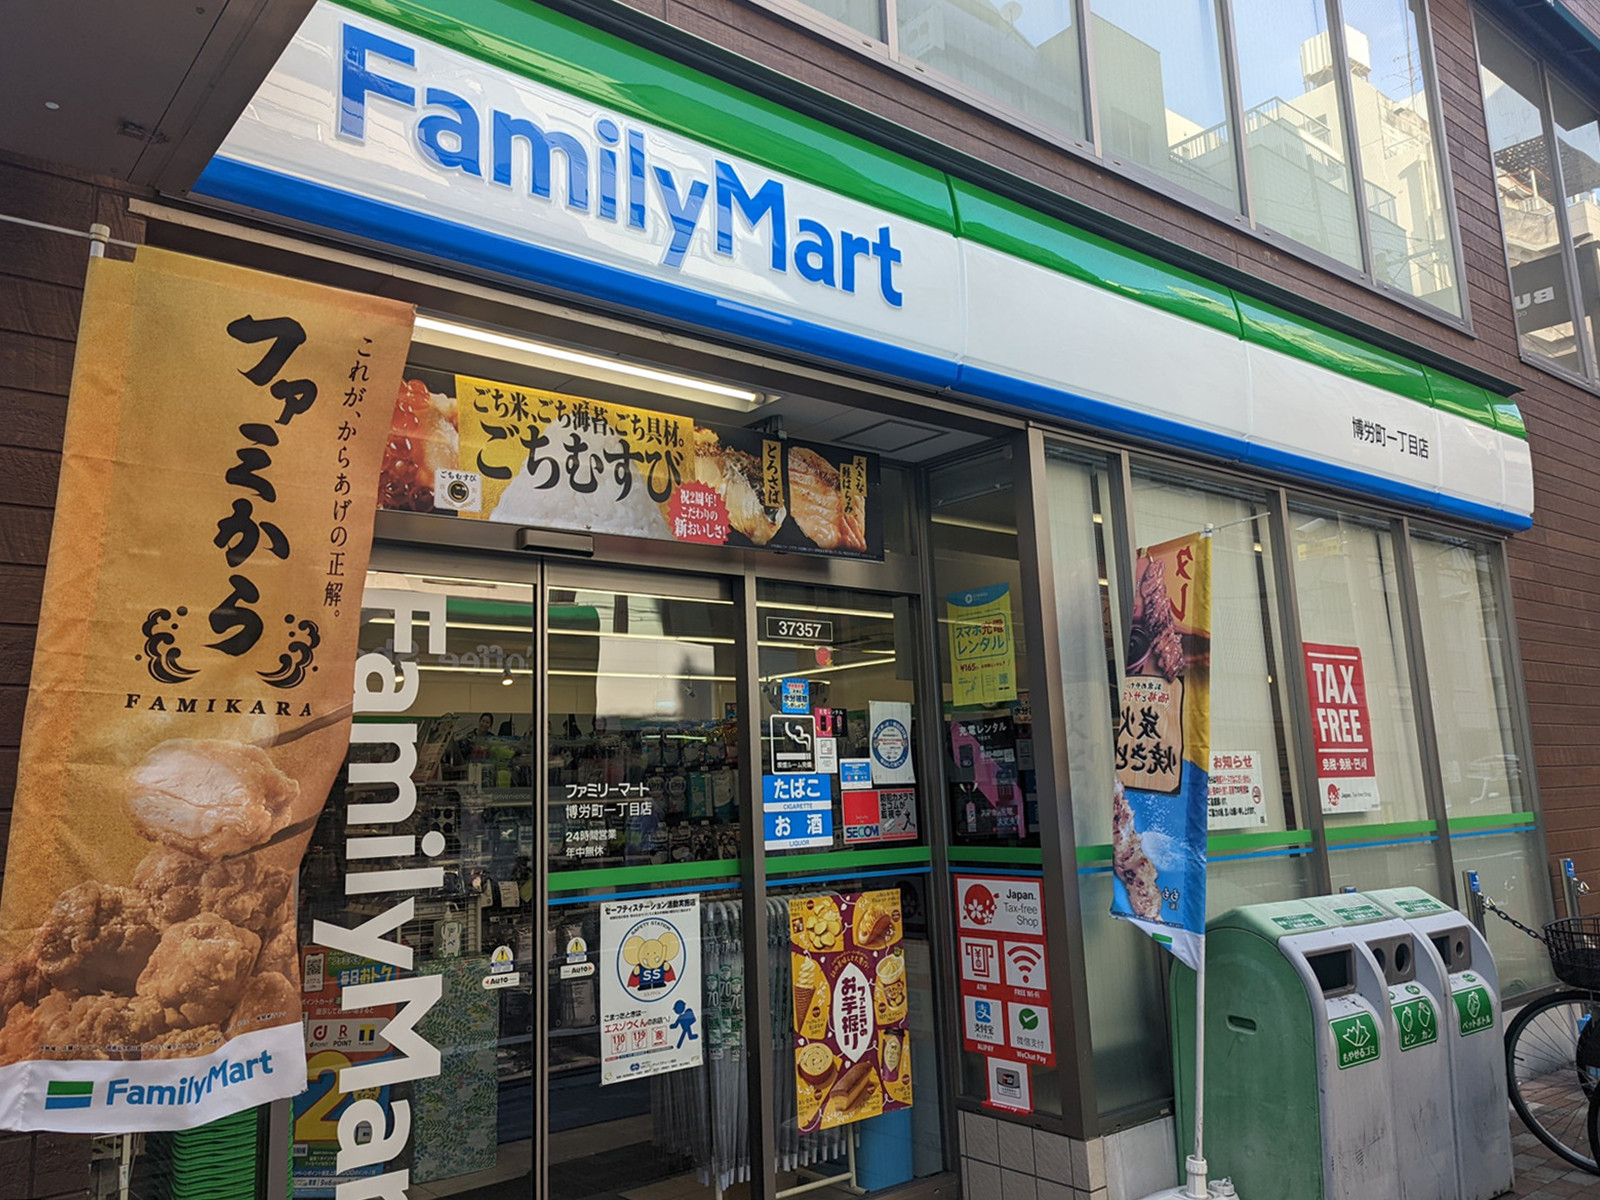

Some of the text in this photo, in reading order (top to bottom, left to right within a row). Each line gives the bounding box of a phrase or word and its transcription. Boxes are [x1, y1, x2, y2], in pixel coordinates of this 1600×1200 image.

[338, 21, 903, 308] FamilyMart
[473, 386, 686, 448] ごち米、ごち海苔、ごち具材。
[1352, 416, 1429, 459] 博労町一丁目店
[476, 421, 682, 504] ごちむすび
[323, 337, 372, 618] これが、からあげの正解。
[766, 444, 780, 506] とろさば
[855, 458, 866, 494] 大きな
[203, 315, 318, 656] ファミから
[842, 466, 853, 513] 鮭はらみ
[680, 506, 718, 521] こだわりの
[778, 621, 822, 637] 37357
[957, 635, 1005, 655] レンタル
[1312, 662, 1358, 704] TAX
[124, 693, 312, 717] FAMIKARA
[958, 721, 1007, 737] 充電レンタル
[1316, 707, 1364, 743] FREE
[1213, 755, 1253, 769] お知らせ
[565, 782, 650, 798] ファミリーマート
[773, 778, 822, 799] たばこ
[565, 802, 652, 819] 博労町一丁目店
[783, 802, 813, 810] CIGARETTE
[565, 829, 617, 842] 24時間営業
[846, 825, 880, 839] SECOM
[565, 847, 604, 858] 年中無休
[1006, 888, 1037, 902] Japan.
[1003, 901, 1038, 915] Tax-free
[631, 920, 672, 935] SAFETY STATION
[1016, 914, 1039, 928] Shop
[340, 965, 393, 985] 毎日おトク
[642, 969, 662, 981] SS
[1014, 988, 1026, 997] FREE
[840, 976, 859, 1050] お芋掘り
[1462, 1016, 1492, 1030] ペットボトル
[612, 1033, 626, 1045] 110
[633, 1029, 646, 1041] 119
[1016, 1036, 1044, 1049] 微信支付
[1404, 1028, 1434, 1045] ビン カン
[1016, 1050, 1047, 1065] WeChat Pay
[1343, 1045, 1377, 1063] もやせるゴミ
[106, 1050, 274, 1106] FamilyMart
